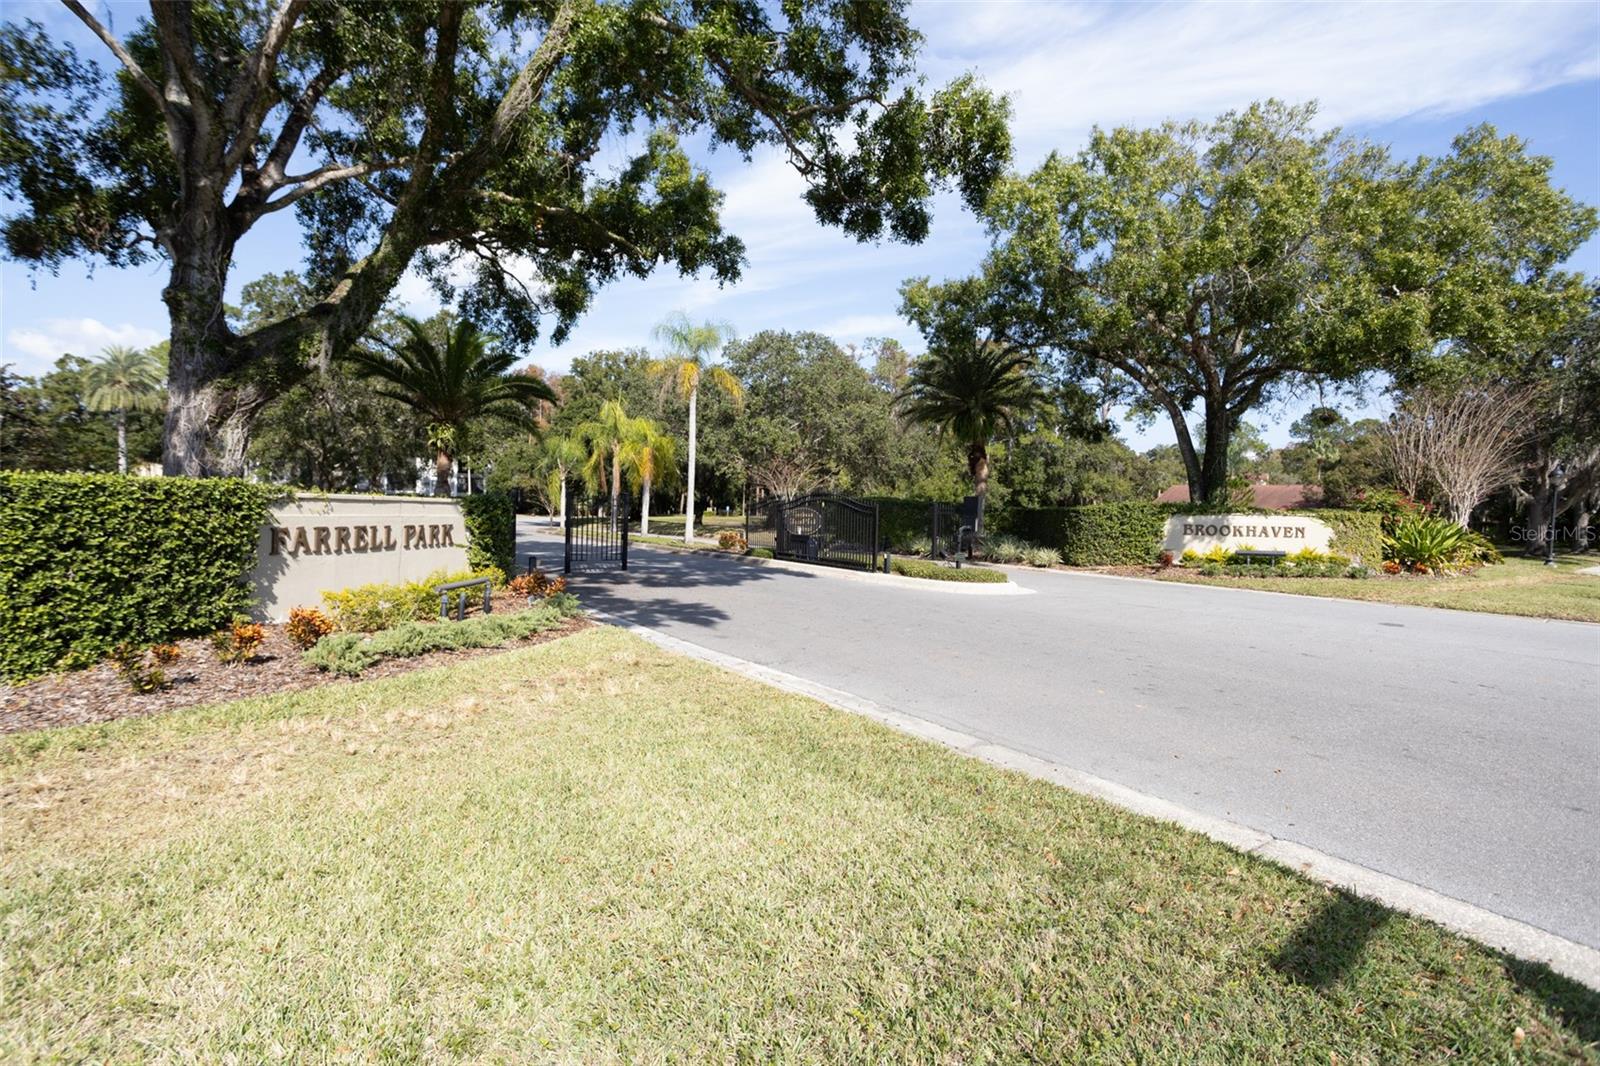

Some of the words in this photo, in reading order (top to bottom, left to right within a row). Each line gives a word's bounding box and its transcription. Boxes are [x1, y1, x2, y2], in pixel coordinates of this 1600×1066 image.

[270, 525, 396, 556] FARRELL
[403, 523, 454, 550] PARK
[1183, 524, 1305, 538] BROOKHAVEN
